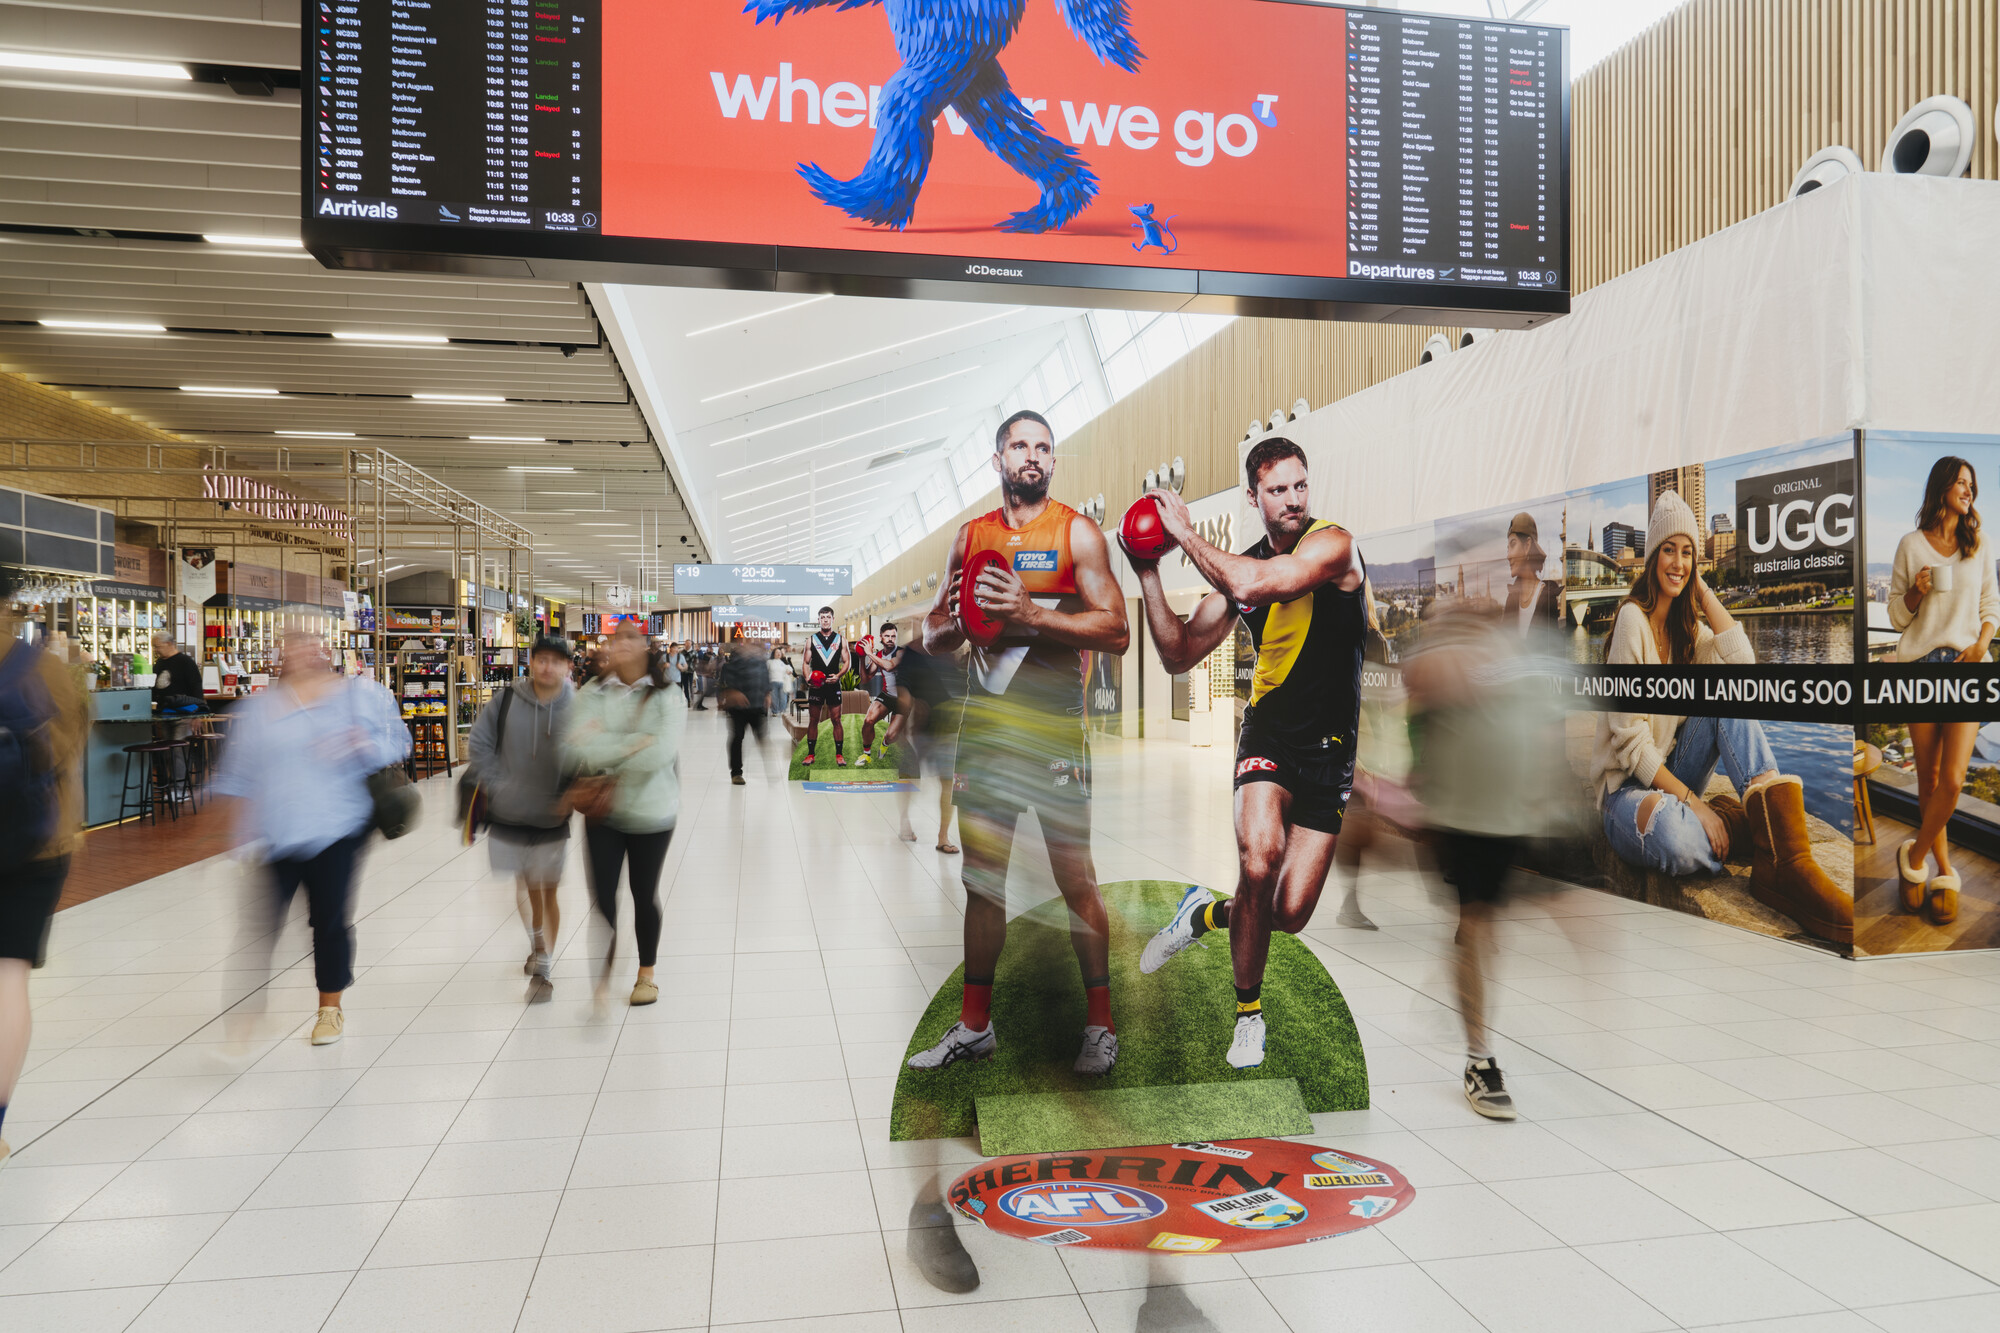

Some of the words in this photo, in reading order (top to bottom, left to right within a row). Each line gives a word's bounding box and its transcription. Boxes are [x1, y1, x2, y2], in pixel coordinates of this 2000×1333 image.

[392, 10, 410, 18] Perth
[536, 12, 560, 20] Delayed
[392, 22, 426, 32] Melbourne
[1402, 28, 1428, 36] Melbourne
[392, 34, 425, 43] Prominent
[1402, 38, 1424, 46] Brisbane
[392, 46, 422, 56] Canberra
[392, 58, 426, 68] Melbourne
[392, 70, 416, 80] Sydney
[407, 83, 434, 92] Augusta
[392, 92, 416, 102] Sydney
[392, 106, 422, 114] Auckland
[392, 116, 416, 126] Sydney
[392, 128, 426, 138] Melbourne
[1060, 100, 1160, 150] we
[1174, 110, 1258, 167] go
[392, 140, 420, 148] Brisbane
[535, 151, 560, 159] Delayed
[392, 152, 418, 161] Olympic
[1402, 154, 1422, 162] Sydney
[392, 164, 416, 174] Sydney
[1402, 164, 1426, 172] Brisbane
[392, 176, 422, 184] Brisbane
[392, 188, 426, 196] Melbourne
[1402, 184, 1422, 192] Sydney
[1402, 194, 1426, 202] Brisbane
[319, 198, 398, 219] Arrivals
[469, 207, 489, 215] Please
[1402, 206, 1430, 214] Melbourne
[469, 215, 495, 223] baggage
[545, 212, 575, 223] 10:33
[1402, 216, 1430, 224] Melbourne
[1402, 226, 1430, 234] Melbourne
[966, 264, 1023, 277] JCDecaux
[1350, 260, 1434, 280] Departures
[1518, 271, 1540, 280] 10:33
[1774, 478, 1822, 494] ORIGINAL
[1747, 493, 1854, 553] UGG
[1017, 553, 1047, 561] TOYO
[1754, 556, 1800, 573] australia
[1804, 552, 1844, 569] classic
[686, 566, 700, 577] 19
[742, 567, 774, 577] 20-50
[249, 575, 268, 588] WINE
[95, 585, 117, 594] DELICIOUS
[734, 627, 781, 638] Adelaide
[1363, 672, 1387, 687] SOON
[1574, 677, 1642, 697] LANDING
[1646, 678, 1695, 700] SOON
[1704, 678, 1796, 703] LANDING
[1802, 680, 1852, 705] SOO
[1864, 678, 1980, 704] LANDING
[1095, 687, 1115, 711] SHADES
[1050, 761, 1068, 771] AFL
[1236, 757, 1275, 778] KFC
[1208, 1147, 1247, 1155] SOUTH
[951, 1156, 1289, 1206] SHERRIN
[1309, 1174, 1382, 1186] ADELAIDE
[1139, 1183, 1197, 1192] KANGAROO
[1016, 1191, 1153, 1217] AFL
[1208, 1192, 1278, 1213] ADELAIDE
